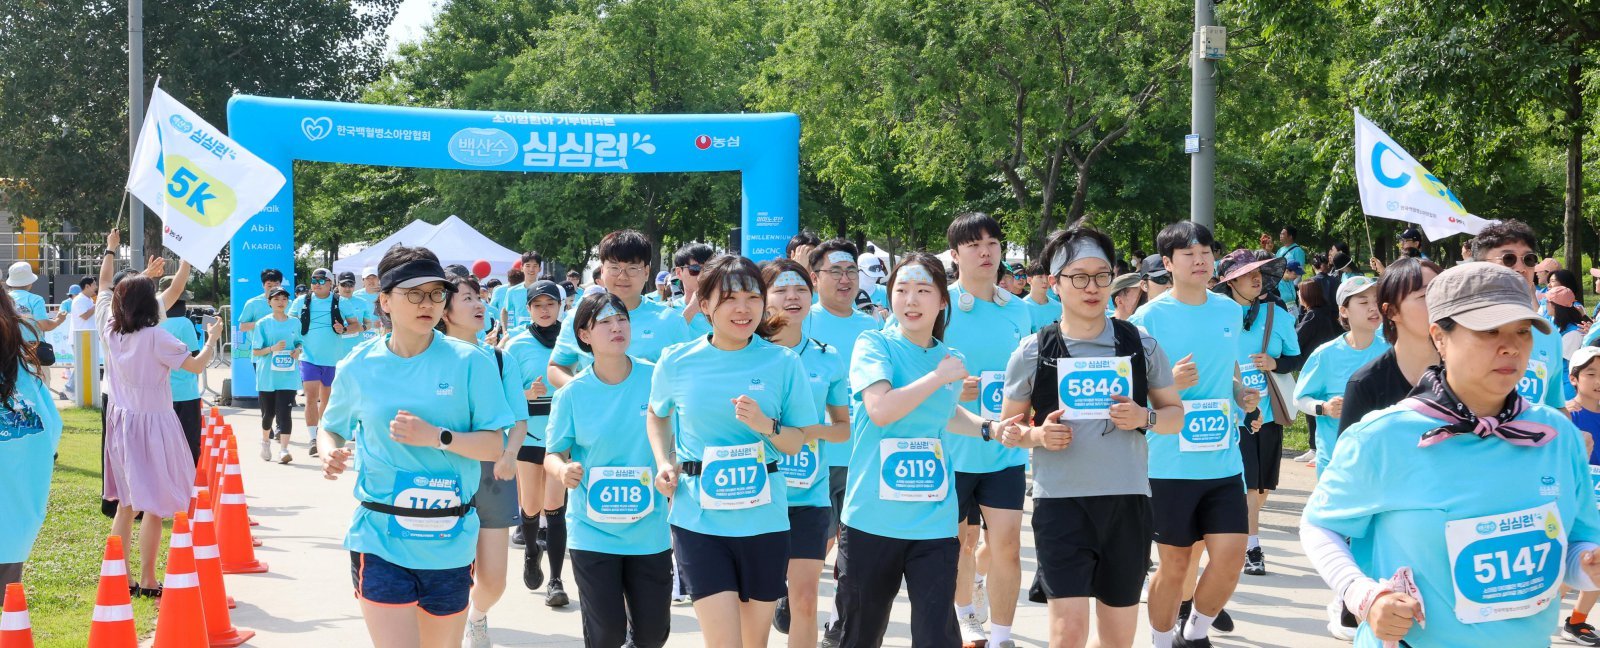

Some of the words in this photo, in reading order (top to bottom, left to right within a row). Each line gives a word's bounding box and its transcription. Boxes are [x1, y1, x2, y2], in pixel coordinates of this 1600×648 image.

[336, 125, 431, 141] 한국백혈병소아암협회
[189, 129, 230, 160] 심심런
[458, 138, 509, 157] 백산수
[522, 131, 629, 169] 심심런
[713, 136, 739, 148] 농심
[167, 166, 217, 216] 5k
[251, 224, 275, 232] Abib
[1089, 360, 1110, 368] 심심런
[1068, 377, 1123, 397] 5846
[1241, 373, 1266, 386] 082
[1189, 416, 1225, 433] 6122
[730, 447, 752, 458] 심심런
[910, 441, 929, 450] 심심런
[615, 469, 636, 479] 심심런
[714, 465, 758, 487] 6117
[894, 459, 936, 478] 6119
[600, 485, 642, 503] 6118
[1499, 513, 1536, 532] 심심런
[1473, 541, 1552, 584] 5147
